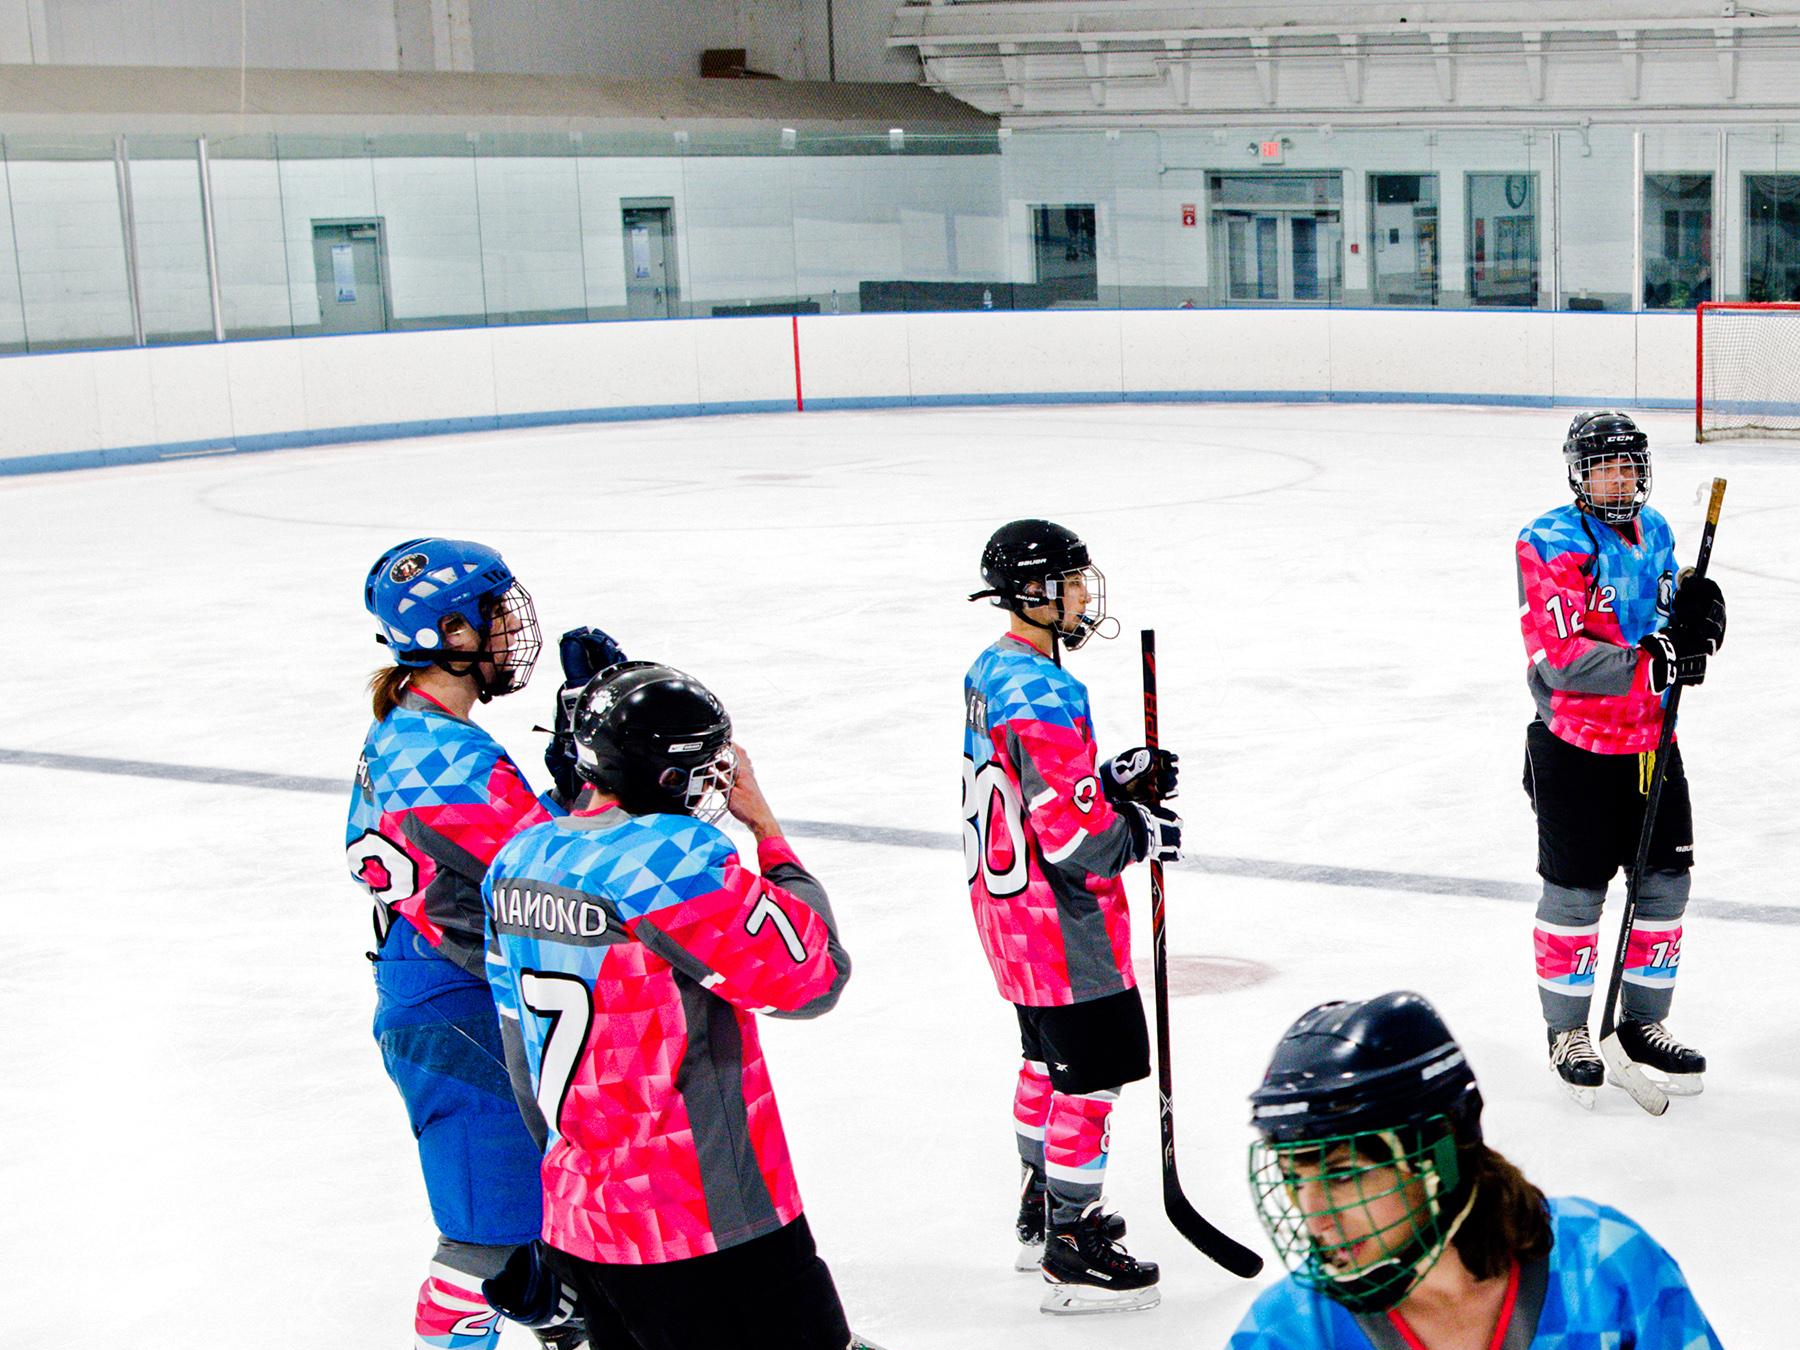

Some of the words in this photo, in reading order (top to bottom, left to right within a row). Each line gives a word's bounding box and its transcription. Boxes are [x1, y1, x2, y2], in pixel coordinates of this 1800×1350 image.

[1607, 435, 1634, 443] CCM
[1017, 558, 1047, 567] BAUER
[1588, 584, 1617, 614] 12
[744, 890, 807, 964] 7
[519, 966, 594, 1138] 7
